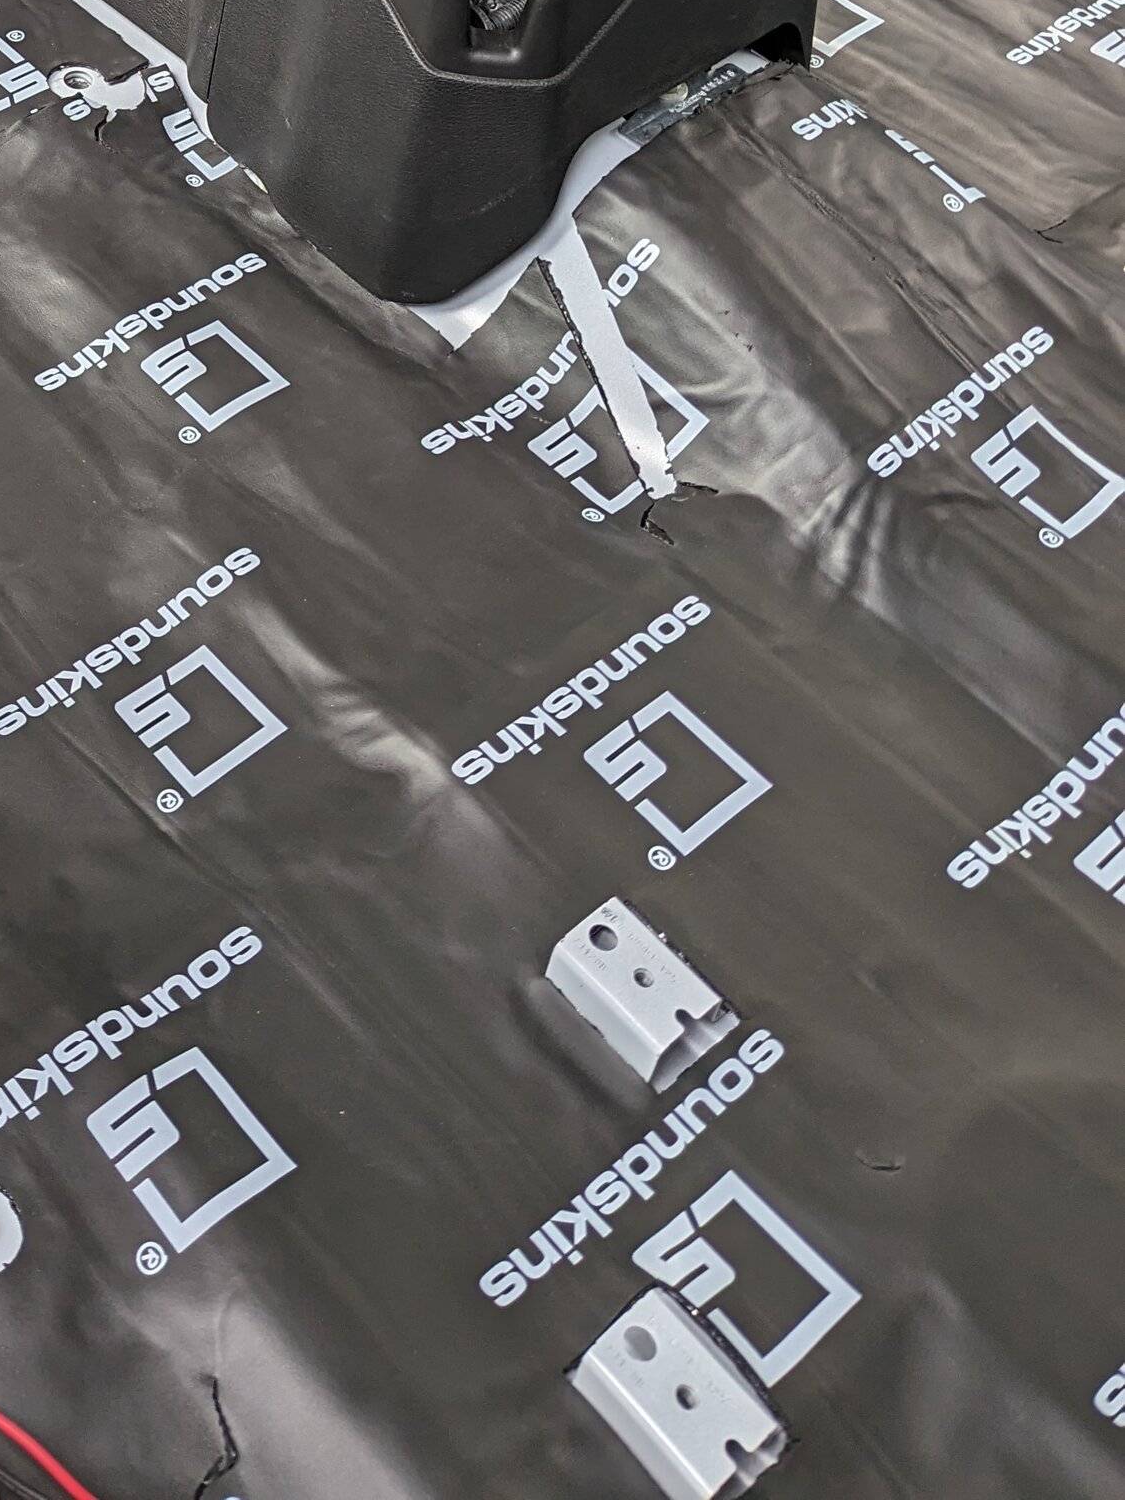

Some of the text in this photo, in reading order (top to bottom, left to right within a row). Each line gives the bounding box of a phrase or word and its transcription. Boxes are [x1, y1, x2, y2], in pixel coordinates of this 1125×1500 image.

[34, 252, 267, 392] soundskins
[867, 325, 1054, 479] soundskins
[451, 595, 712, 785] soundskins
[478, 1028, 785, 1307] soundskins
